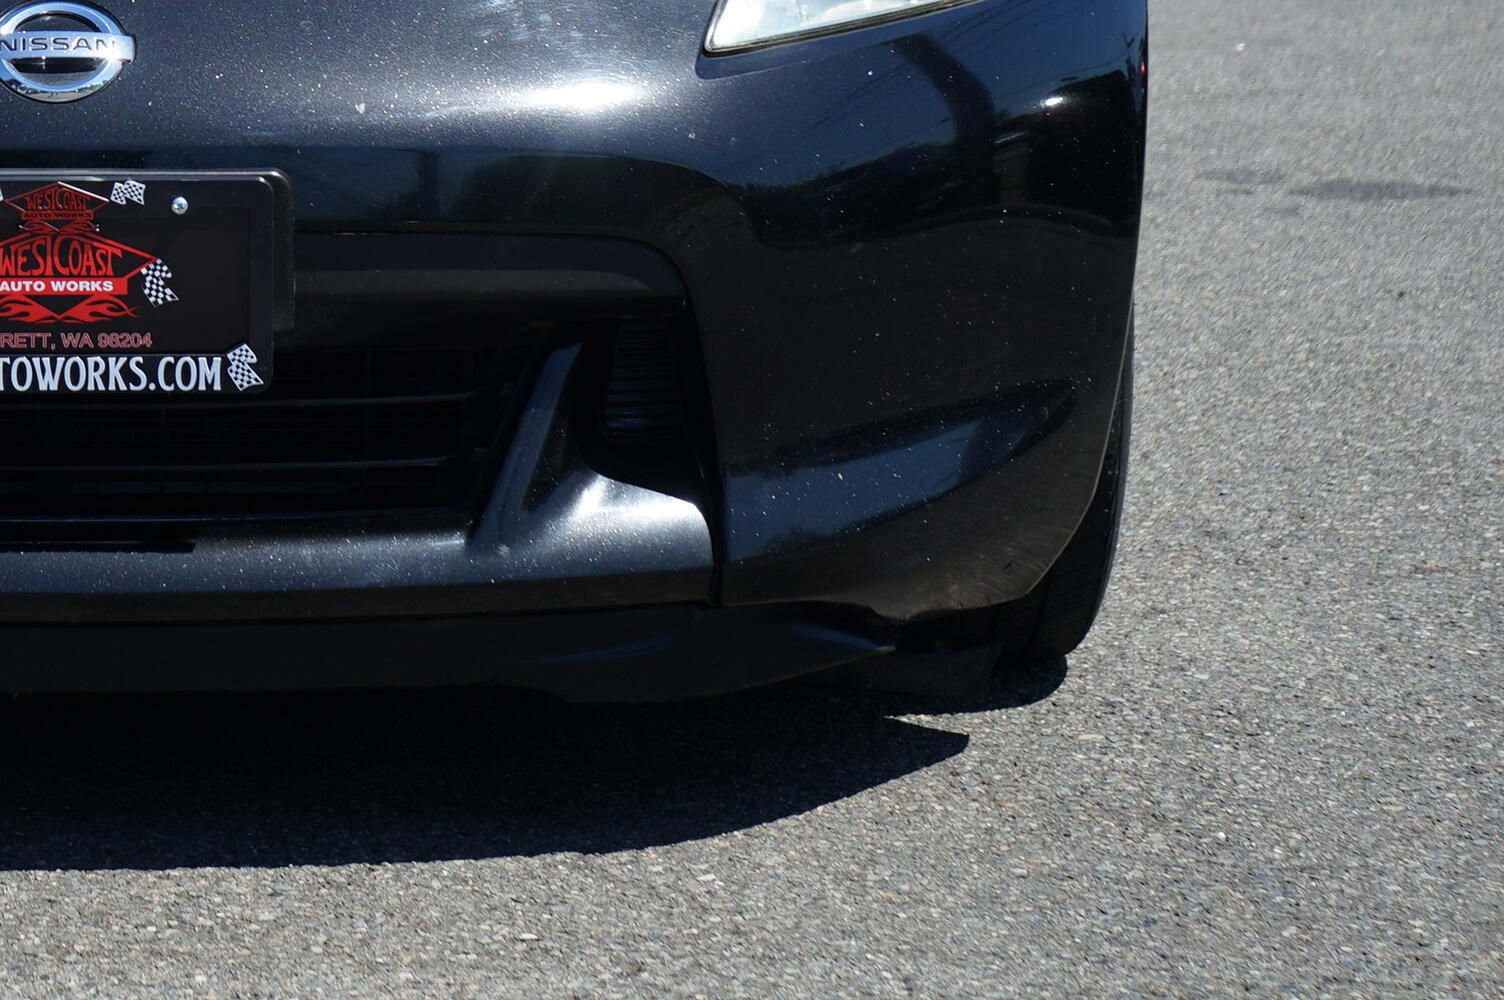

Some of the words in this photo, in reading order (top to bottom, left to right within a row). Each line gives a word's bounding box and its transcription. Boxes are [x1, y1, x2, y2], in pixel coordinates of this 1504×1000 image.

[0, 280, 46, 292] AUTO
[50, 280, 114, 292] WORKS
[60, 332, 94, 349] WA
